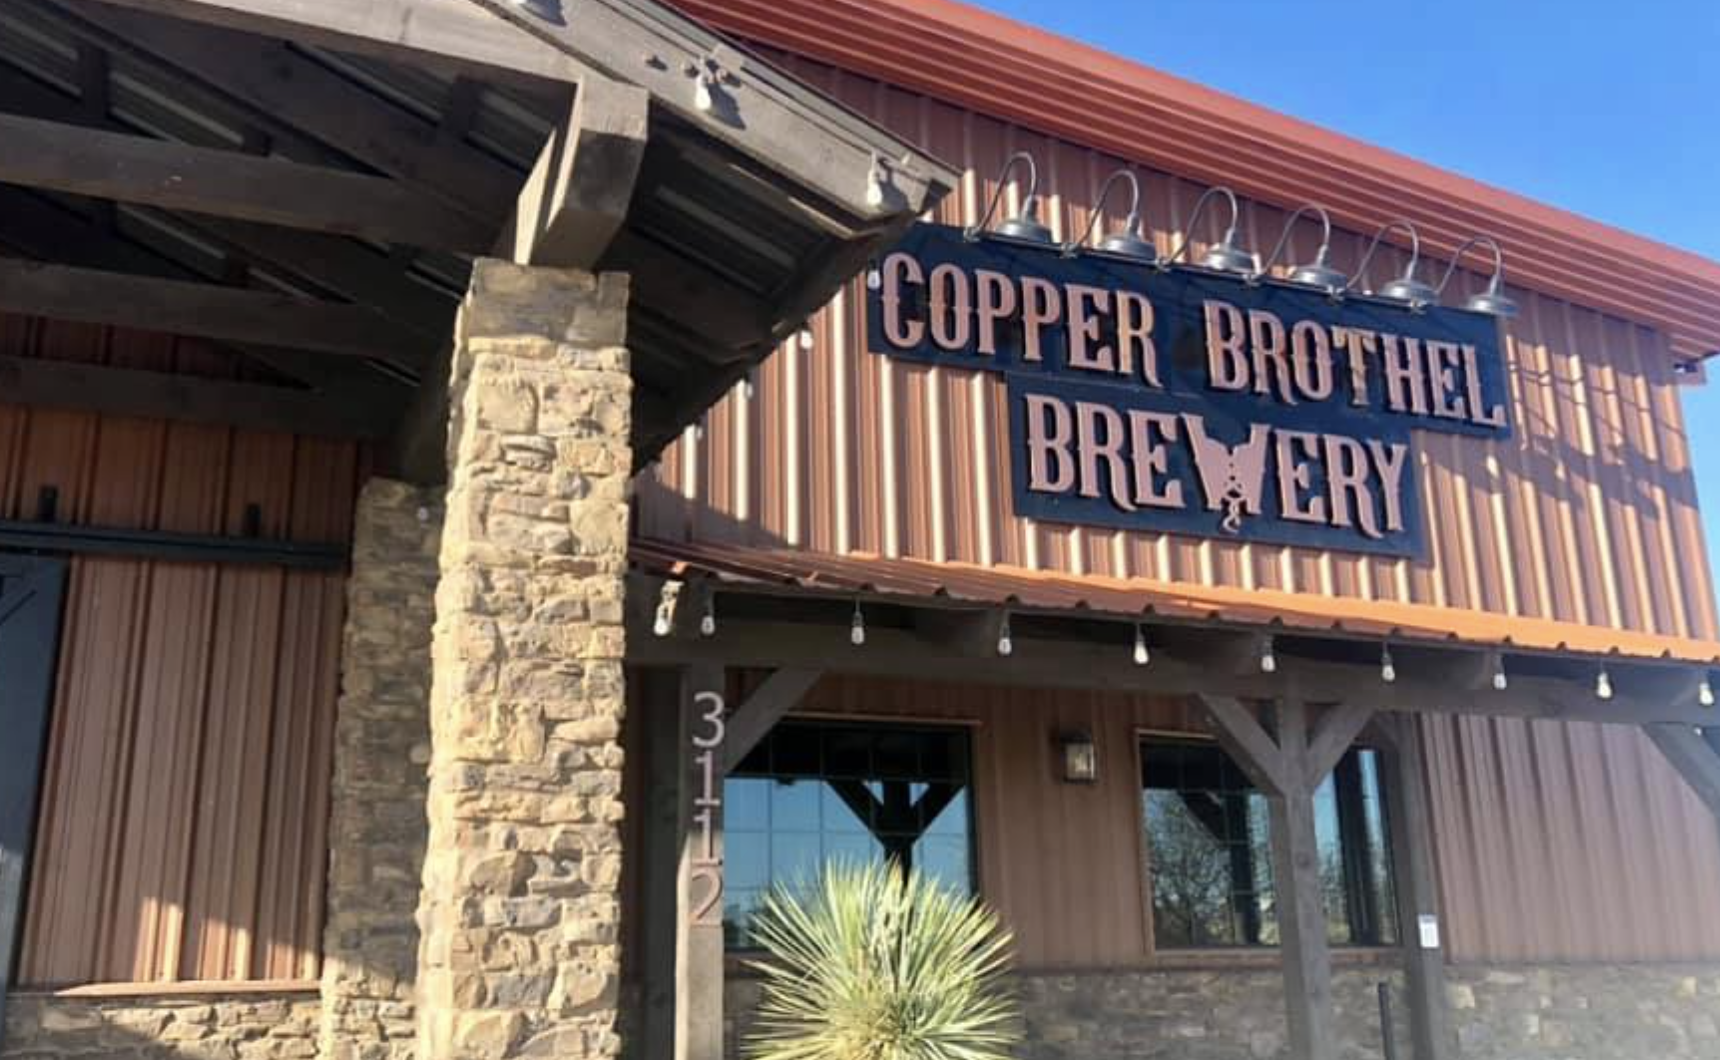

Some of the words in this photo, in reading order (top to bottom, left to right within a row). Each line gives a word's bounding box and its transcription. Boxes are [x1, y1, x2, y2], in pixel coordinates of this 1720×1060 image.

[881, 251, 1163, 388] COPPER
[1203, 299, 1507, 428] BROTHEL
[1025, 393, 1408, 538] BREWERY
[690, 690, 725, 926] 3112
